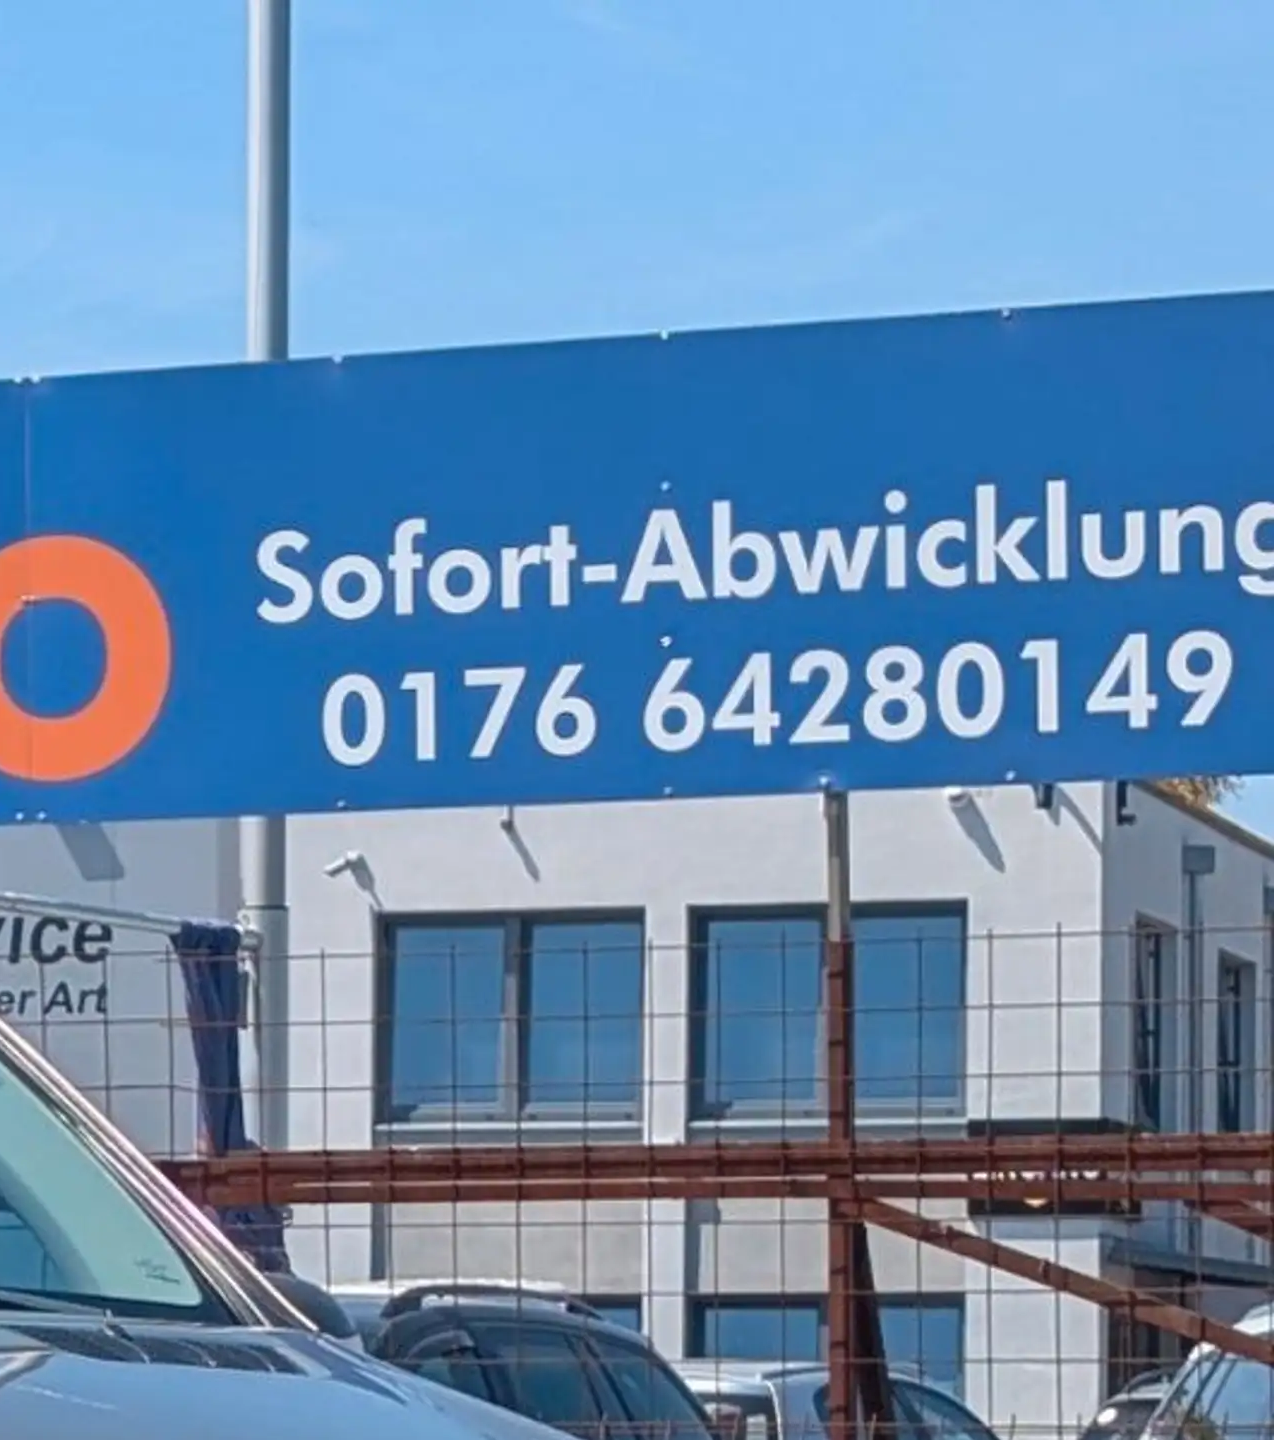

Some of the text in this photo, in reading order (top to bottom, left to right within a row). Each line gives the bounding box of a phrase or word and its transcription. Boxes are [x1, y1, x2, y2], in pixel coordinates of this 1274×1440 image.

[255, 479, 1274, 624] Sofort-Abwicklung
[321, 630, 1233, 766] 0176 64280149
[44, 981, 108, 1014] Art
